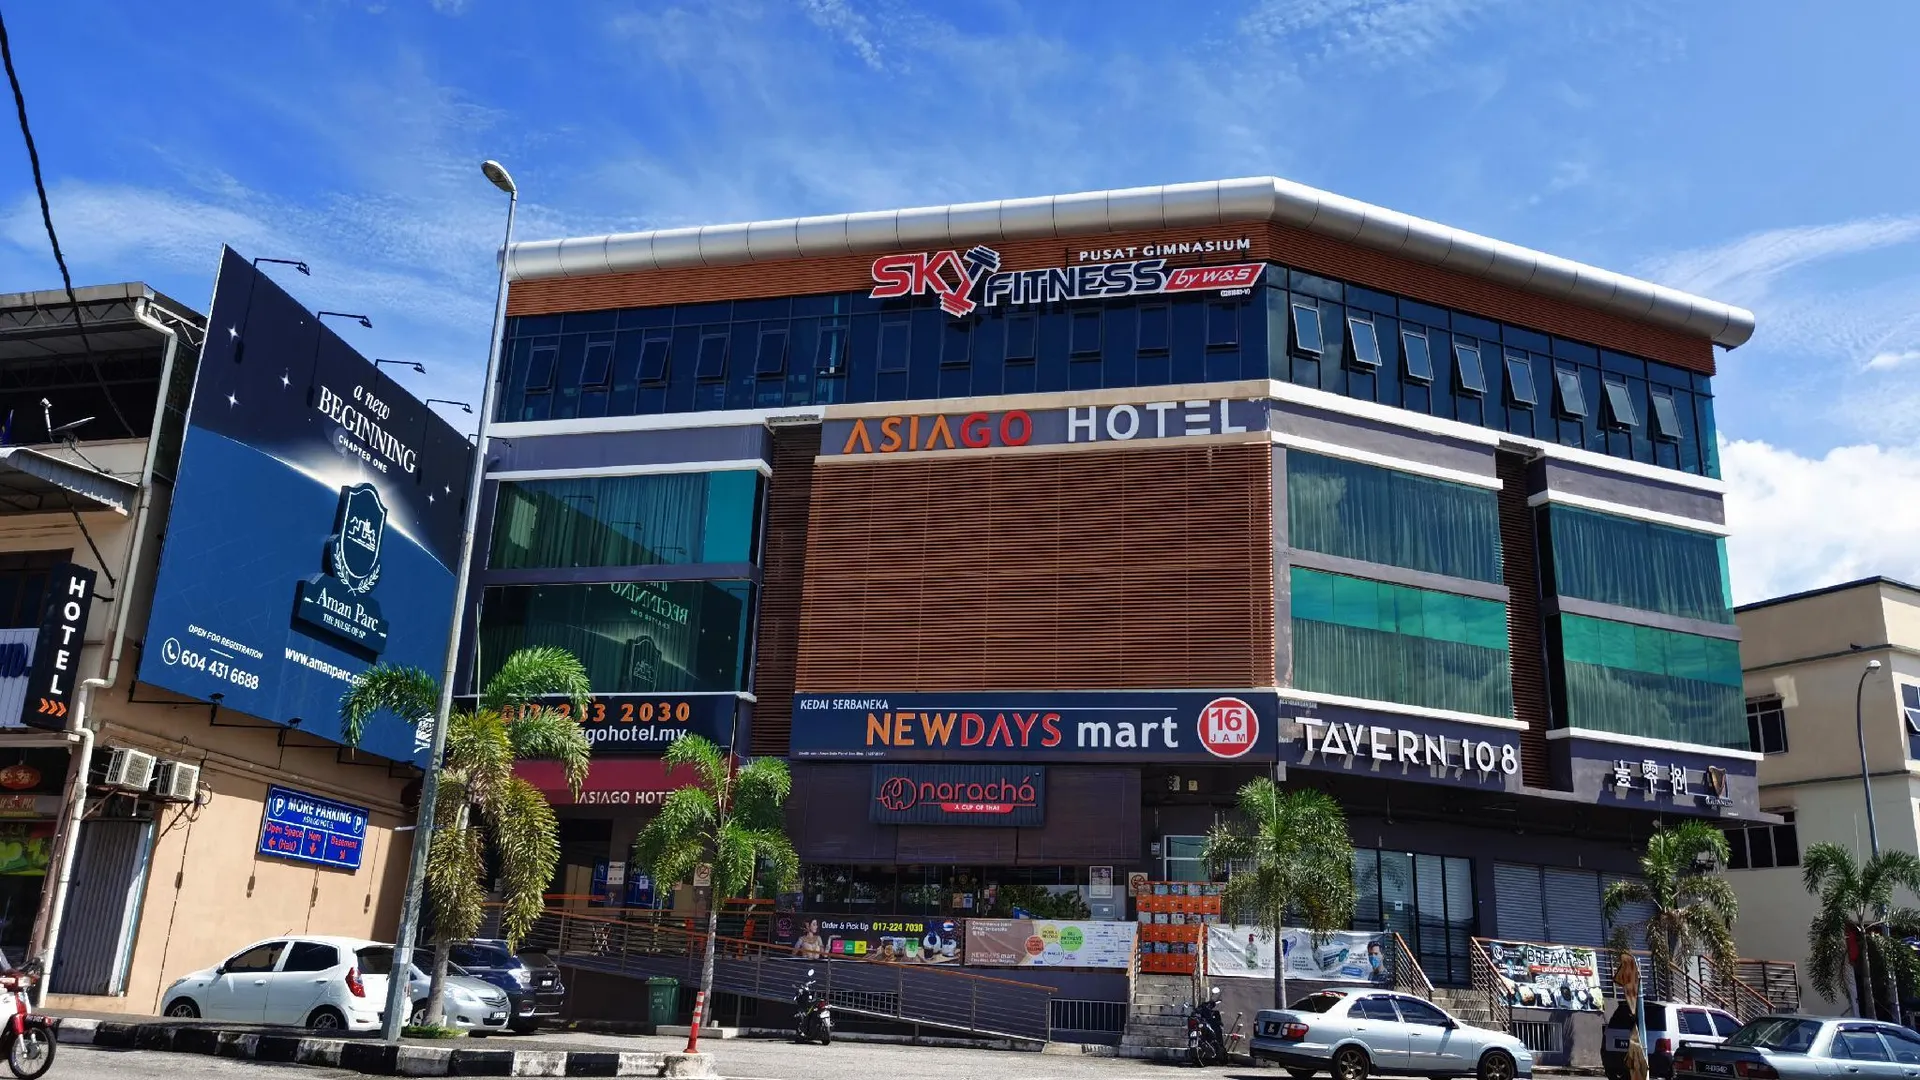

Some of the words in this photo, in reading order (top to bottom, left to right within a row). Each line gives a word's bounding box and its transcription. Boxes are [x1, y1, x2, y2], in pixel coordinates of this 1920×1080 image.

[1079, 246, 1137, 262] PUSAT
[1142, 238, 1251, 257] GIMNASIUM
[869, 245, 1001, 318] SKY
[983, 258, 1168, 307] FITNESS
[1174, 269, 1198, 288] by
[1202, 268, 1252, 283] W&S
[353, 385, 364, 401] a
[364, 392, 390, 421] new
[317, 385, 417, 474] BEGINNING
[843, 408, 1033, 455] ASIAGO
[1068, 398, 1247, 443] HOTEL
[338, 434, 371, 462] CHAPTER
[372, 458, 388, 473] ONE
[316, 587, 352, 620] Aman
[353, 603, 379, 632] Parc
[49, 576, 86, 695] HOTEL
[188, 623, 207, 638] OPEN
[206, 631, 221, 643] FOR
[220, 637, 264, 660] REGISTRATION
[181, 649, 207, 672] 604
[208, 660, 230, 680] 431
[230, 667, 260, 690] 6688
[620, 702, 690, 722] 2030
[799, 699, 830, 711] KEDAI
[831, 698, 889, 711] SERBANEKA
[865, 712, 1062, 748] NEWDAYS
[1077, 716, 1178, 749] mart
[1209, 708, 1243, 732] 16
[1209, 733, 1247, 743] JAM
[1295, 716, 1448, 768] TAVERN
[1461, 738, 1519, 775] 108
[920, 776, 1035, 802] narachá
[1614, 759, 1689, 796] 壹零捌
[287, 797, 315, 816] MORE
[315, 803, 352, 825] PARKING
[579, 791, 630, 804] ASIAGO
[635, 791, 676, 804] HOTE
[266, 822, 283, 835] Open
[284, 825, 304, 838] Space
[307, 830, 322, 842] Here
[330, 835, 358, 849] Basement
[821, 921, 839, 930] Order
[845, 921, 860, 930] Pick
[859, 921, 869, 931] Up
[872, 922, 903, 932] 017-224
[905, 922, 923, 932] 7030
[1527, 948, 1593, 967] BREAKFAST
